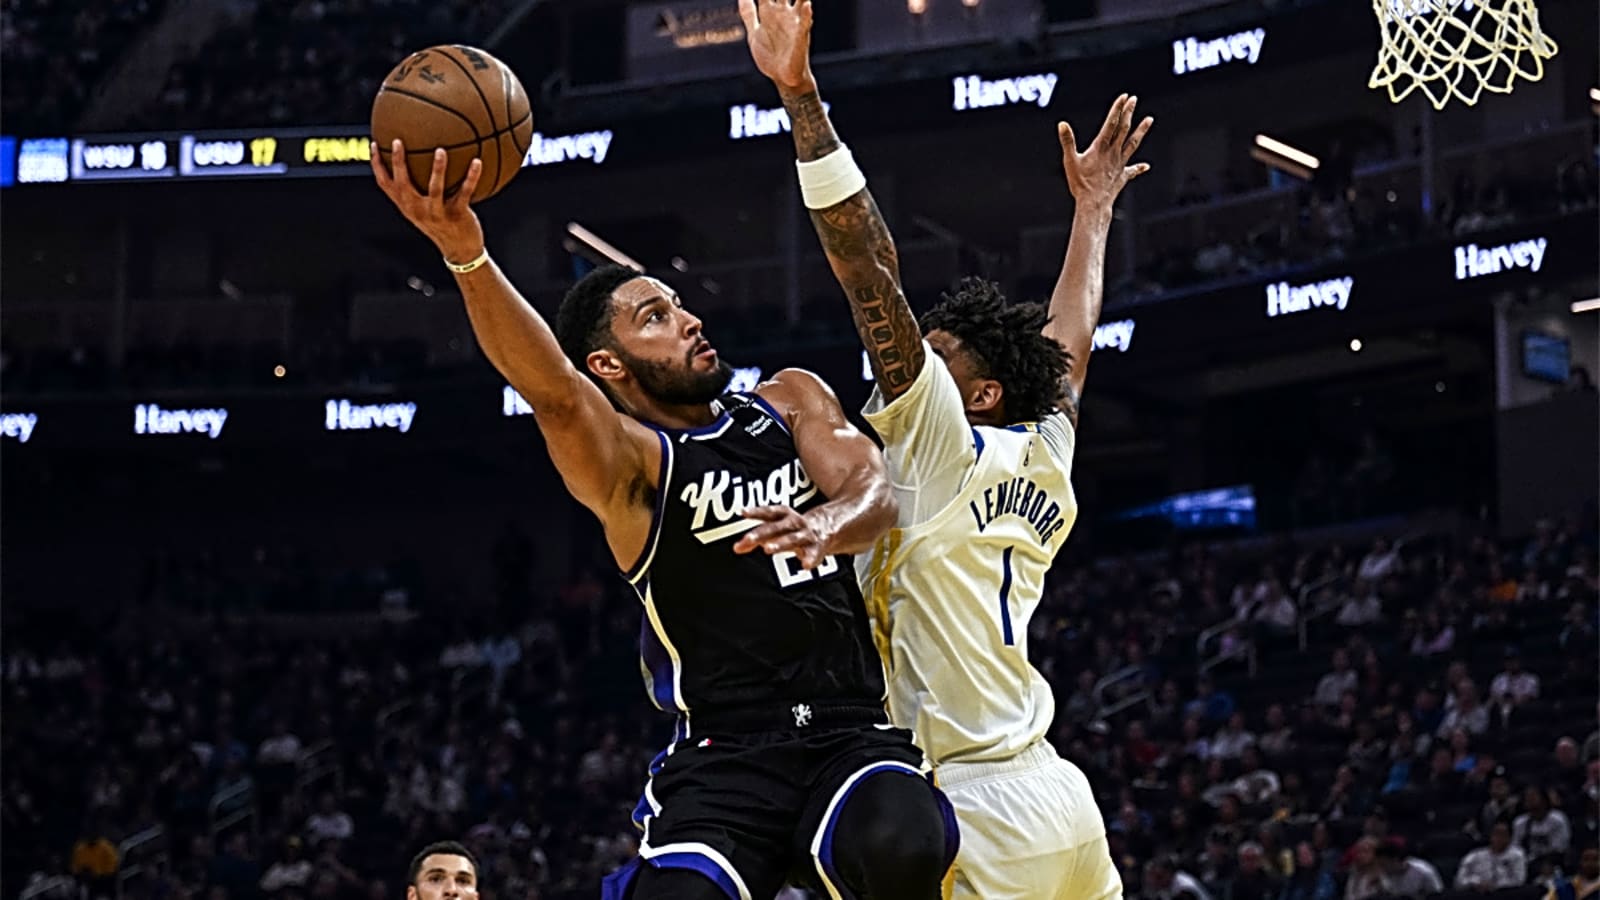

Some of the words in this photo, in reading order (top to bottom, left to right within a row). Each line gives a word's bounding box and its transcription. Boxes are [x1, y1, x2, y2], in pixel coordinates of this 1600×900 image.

[1173, 28, 1265, 75] Harvey
[953, 73, 1057, 111] Harvey
[1455, 237, 1546, 280] Harvey
[1266, 276, 1353, 317] Harvey
[134, 403, 228, 439] Harvey
[325, 400, 417, 433] Harvey
[969, 476, 1065, 547] LENDEBORG
[999, 545, 1015, 646] 1
